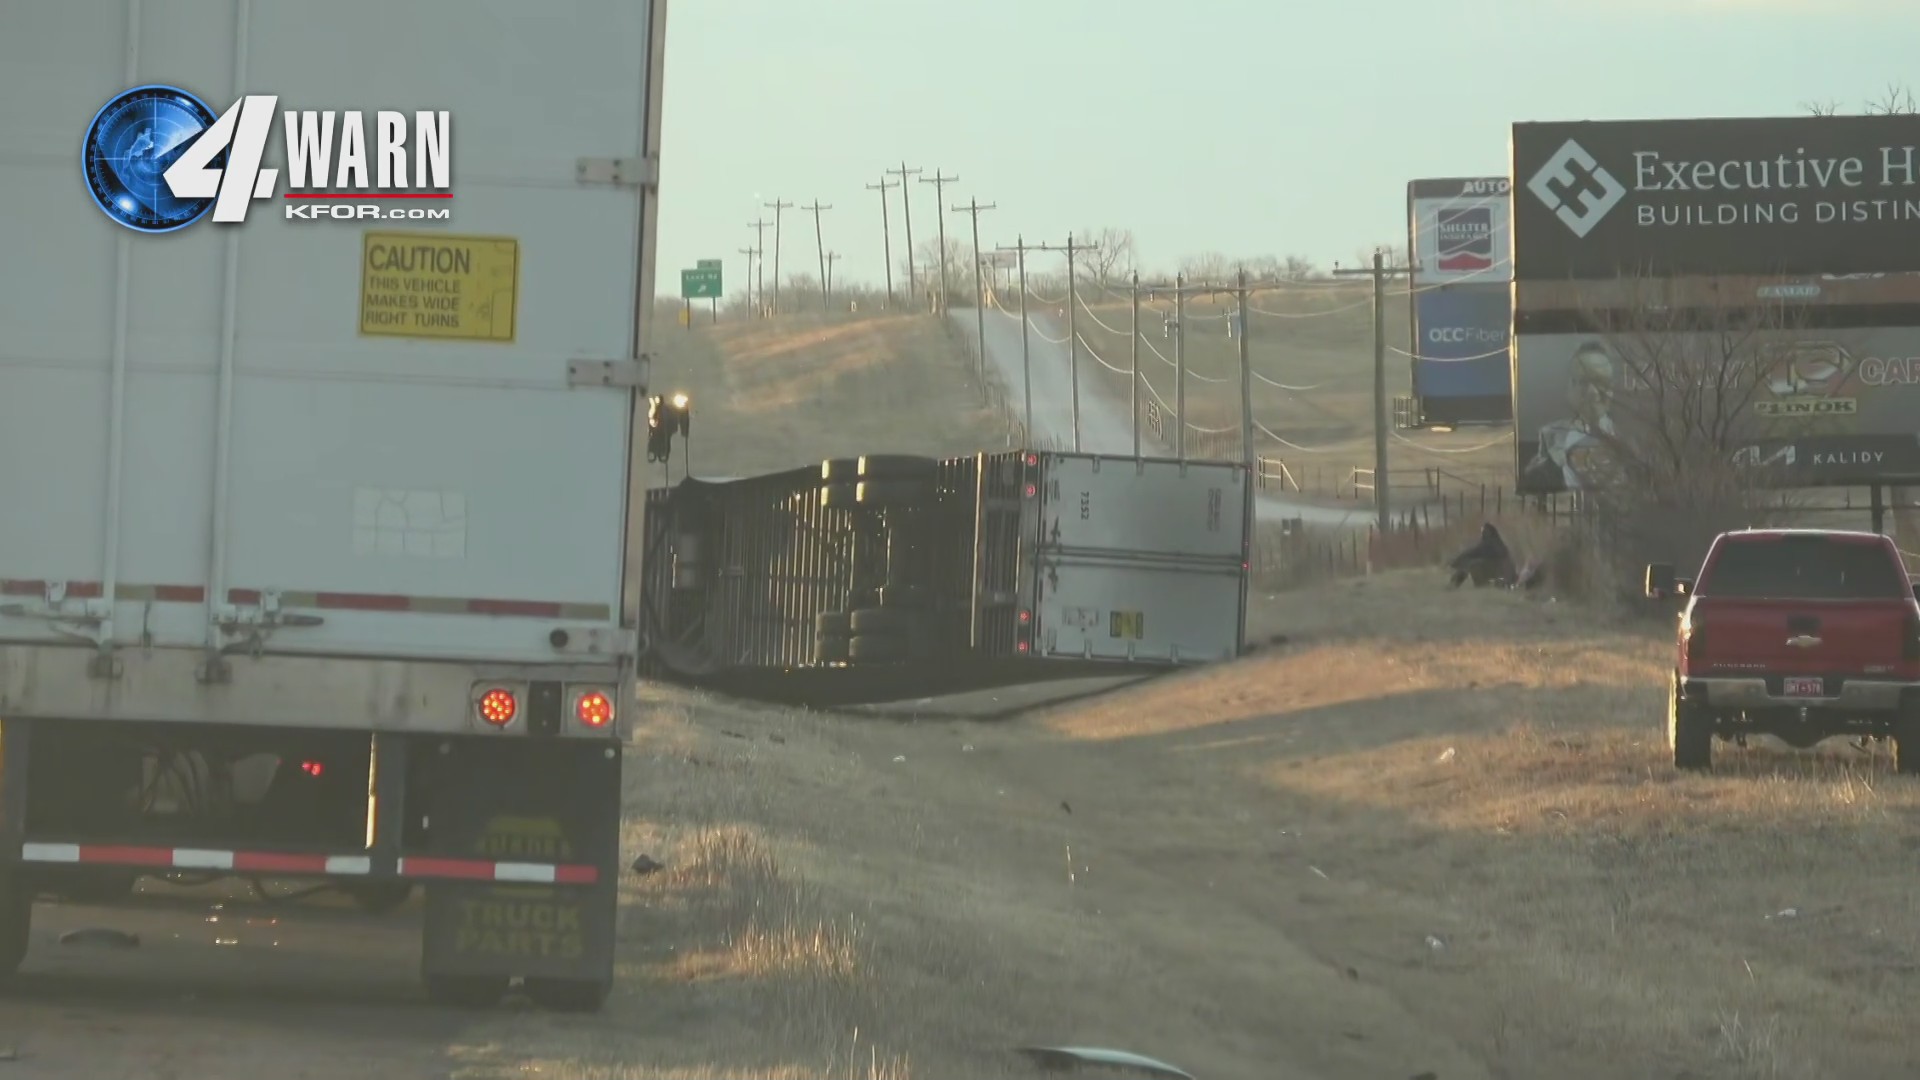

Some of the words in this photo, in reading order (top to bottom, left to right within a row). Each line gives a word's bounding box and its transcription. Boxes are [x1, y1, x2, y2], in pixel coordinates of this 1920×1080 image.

[1632, 147, 1863, 191] Executive
[1879, 146, 1920, 186] H
[1463, 179, 1510, 193] AUTO
[1638, 202, 1799, 226] BUILDING
[1439, 222, 1489, 233] SHELTER
[369, 243, 470, 275] CAUTION
[369, 276, 399, 291] THIS
[403, 278, 461, 294] VEHICLE
[366, 293, 418, 309] MAKES
[423, 295, 461, 310] WIDE
[365, 310, 408, 325] RIGHT
[414, 312, 460, 328] TURNS
[1786, 403, 1810, 412] IN
[1814, 401, 1853, 411] OK
[1814, 451, 1885, 465] KALIDY
[462, 899, 581, 931] TRUCK
[455, 927, 583, 958] PARTS
